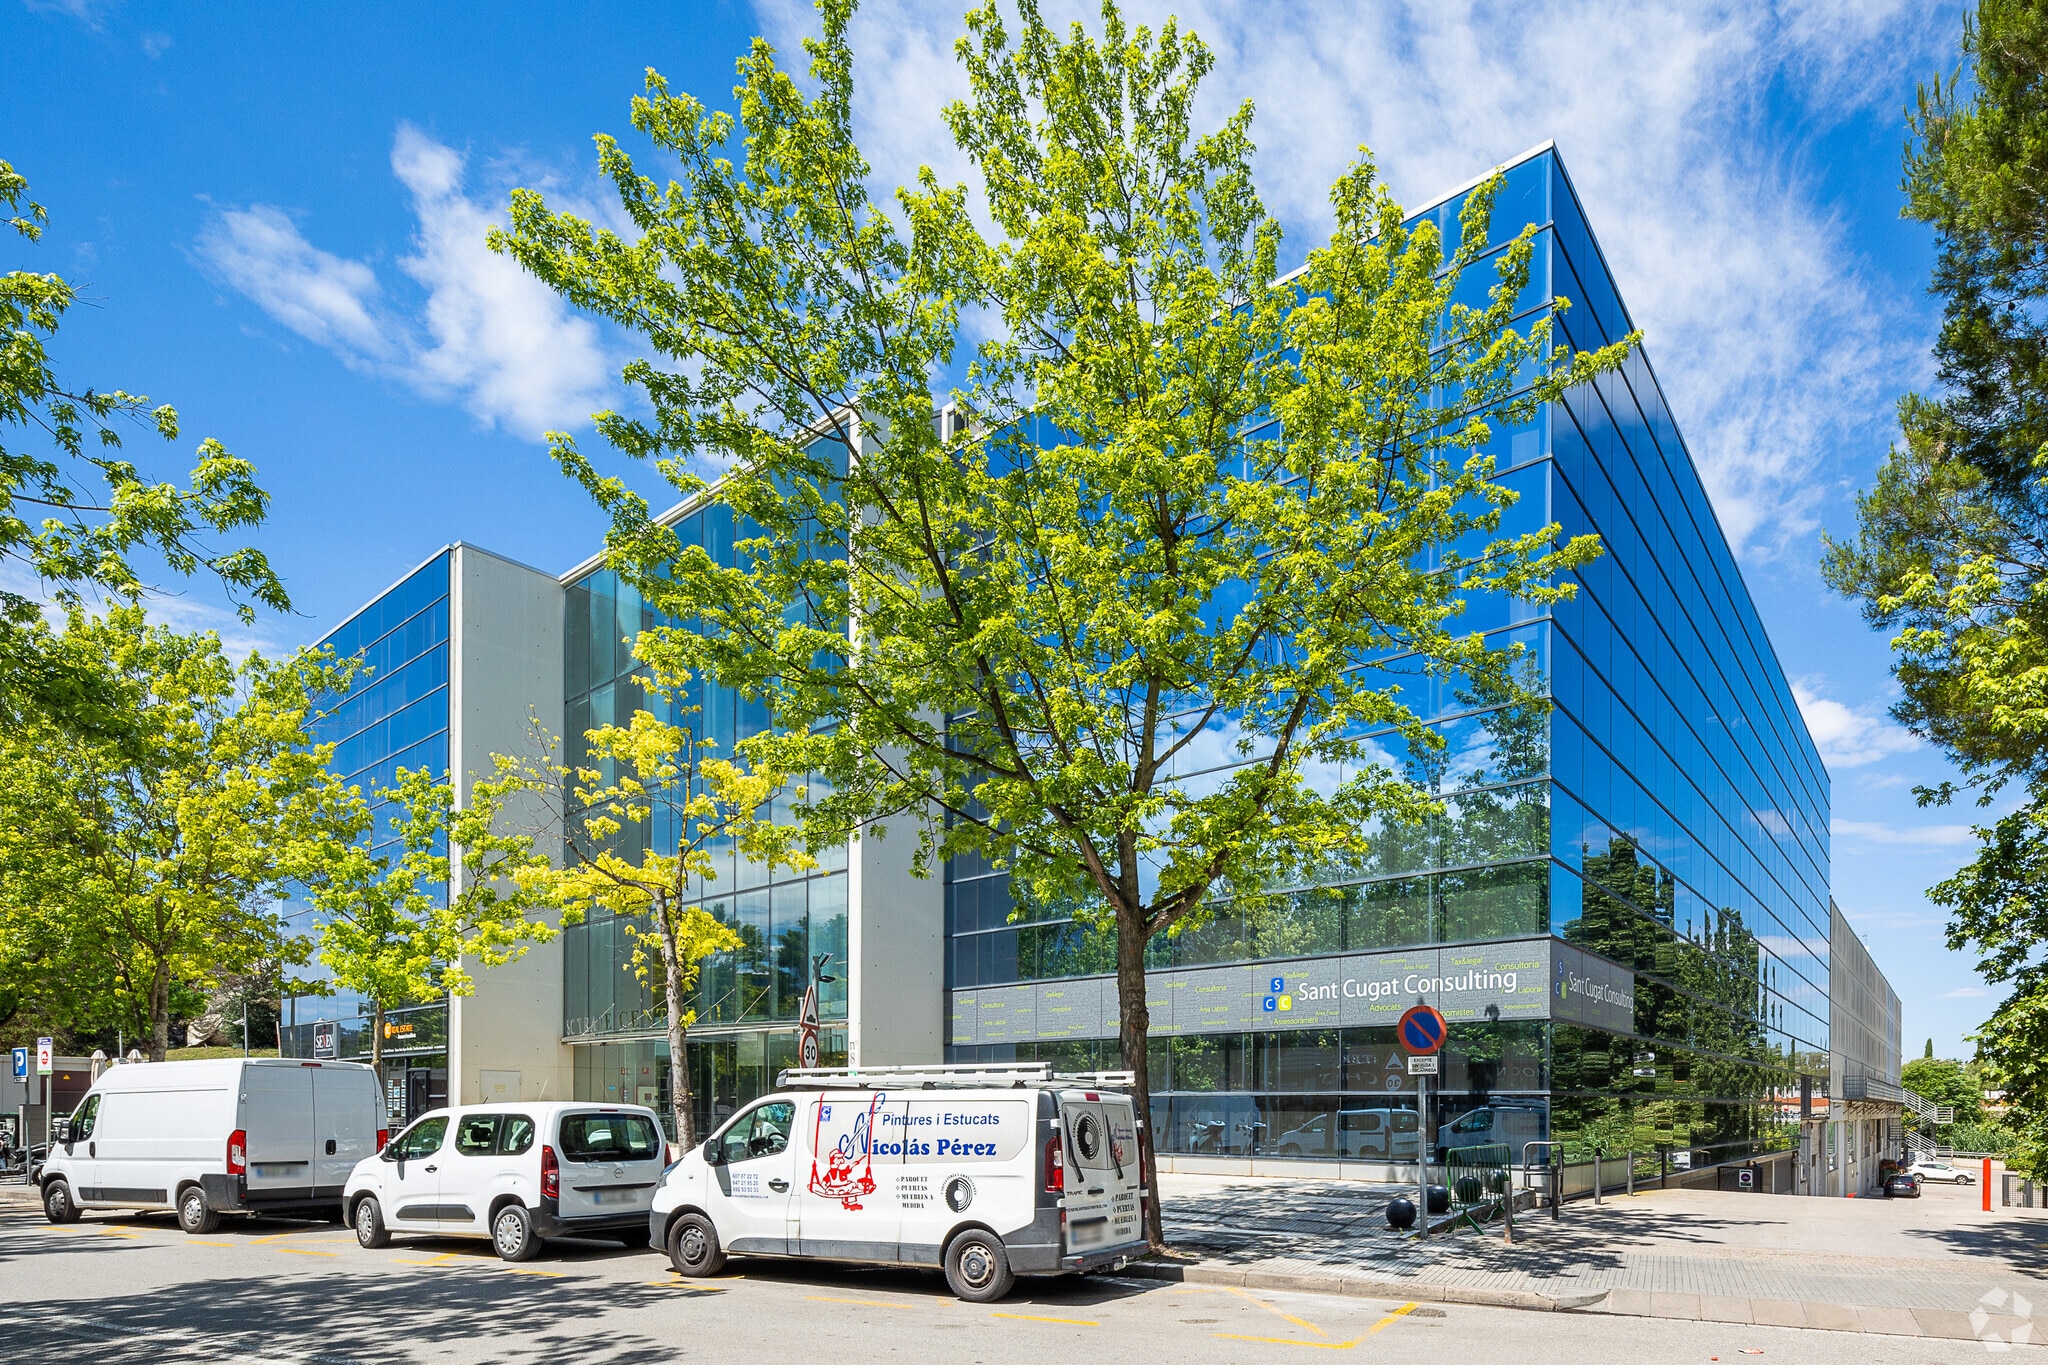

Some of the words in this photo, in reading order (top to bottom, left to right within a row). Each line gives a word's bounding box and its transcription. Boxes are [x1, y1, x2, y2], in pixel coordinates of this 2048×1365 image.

[1450, 957, 1483, 966] Tax&legal
[1495, 960, 1540, 971] Consultoria
[1273, 979, 1281, 990] S
[1298, 982, 1338, 1001] Sant
[1343, 978, 1400, 1001] Cugat
[1404, 969, 1517, 994] Consulting
[1568, 971, 1584, 995] Sant
[1585, 977, 1604, 1004] Cugat
[1604, 984, 1634, 1014] Consulting
[1265, 999, 1273, 1010] C
[1281, 997, 1289, 1008] C
[1369, 1003, 1402, 1012] Advocats
[805, 1045, 816, 1060] 30
[15, 1051, 24, 1074] P
[882, 1113, 932, 1126] Pintures
[943, 1112, 1000, 1125] Estucats
[937, 1139, 997, 1156] Pérez
